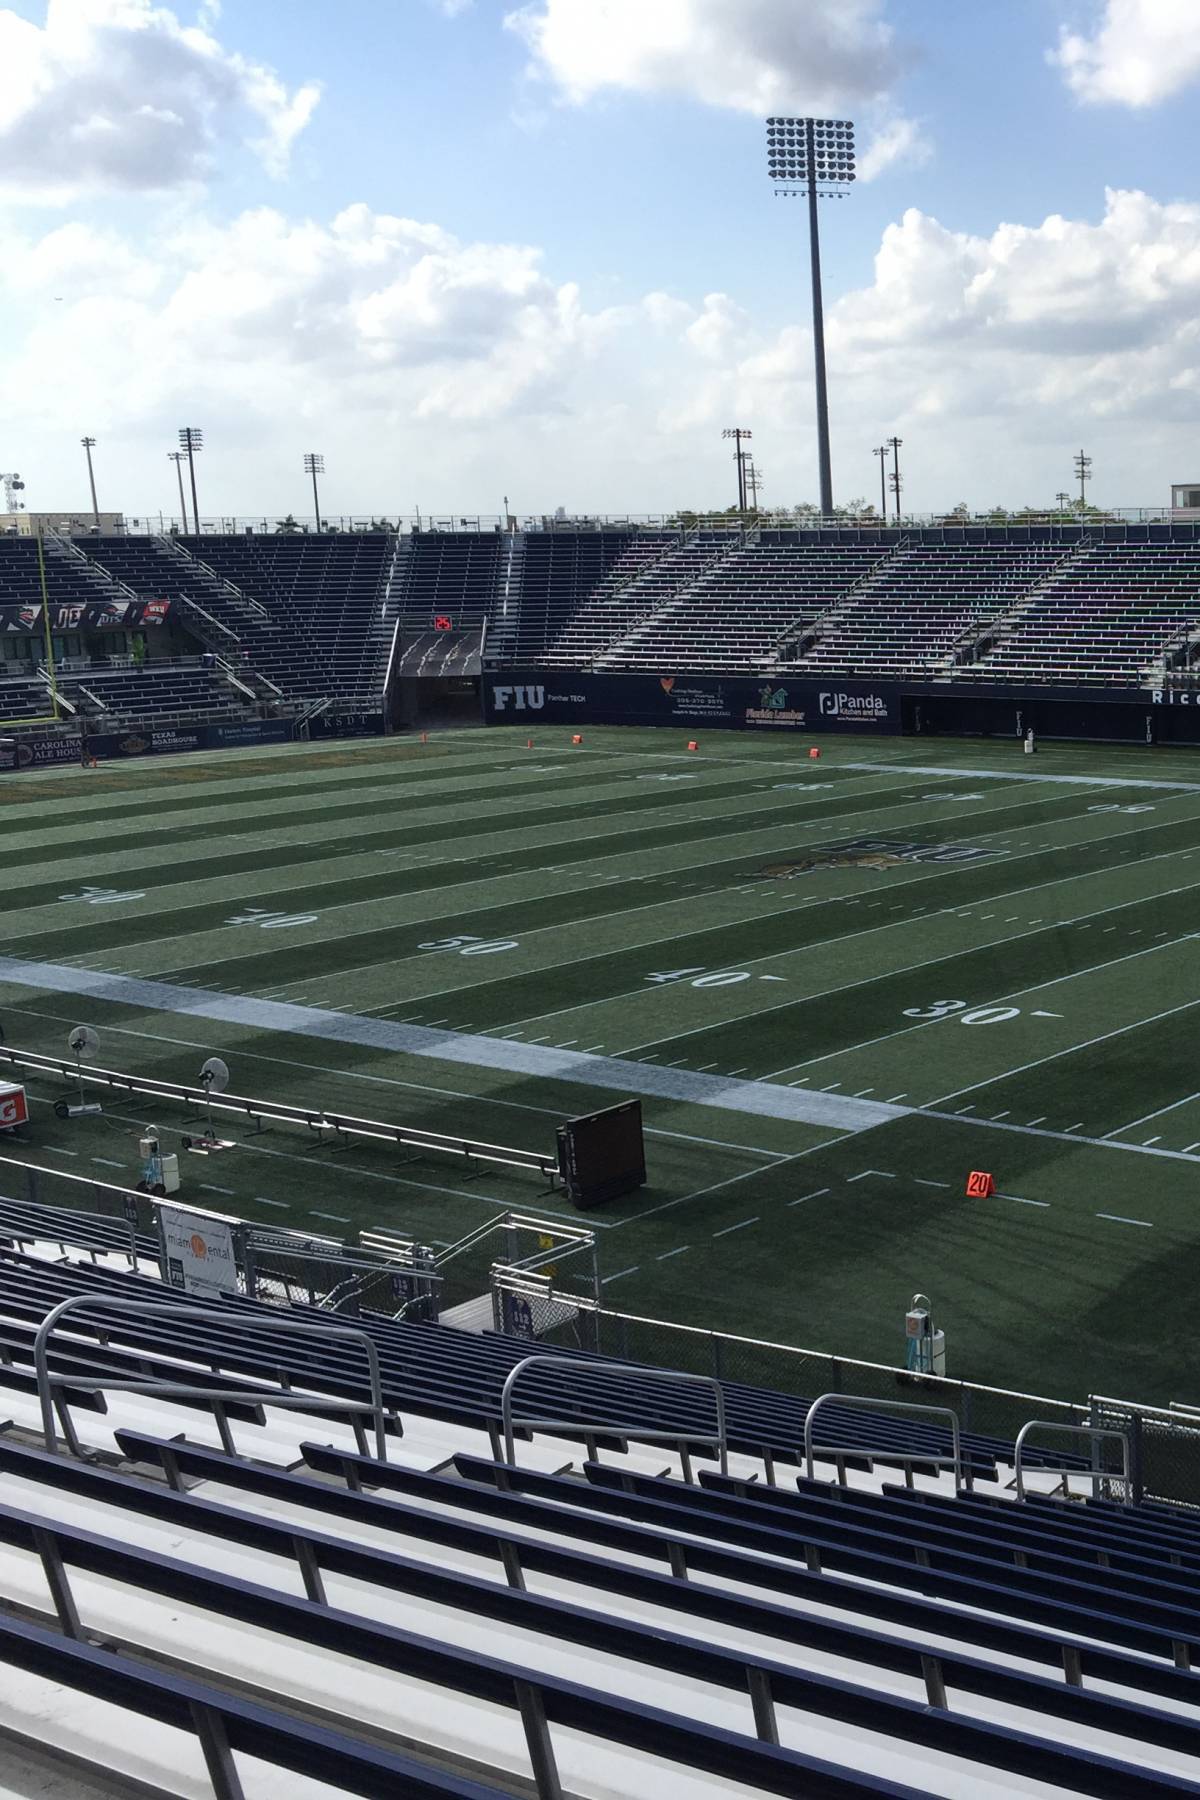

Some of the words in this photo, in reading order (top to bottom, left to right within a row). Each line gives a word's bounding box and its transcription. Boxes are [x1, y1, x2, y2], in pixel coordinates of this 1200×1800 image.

[492, 685, 545, 710] FIU
[838, 693, 884, 709] Panda
[323, 715, 369, 728] KSDT
[33, 739, 82, 751] CAROLINA
[56, 748, 82, 757] HOUS
[644, 967, 751, 987] 40
[902, 1000, 1021, 1025] 30
[970, 1173, 988, 1193] 20
